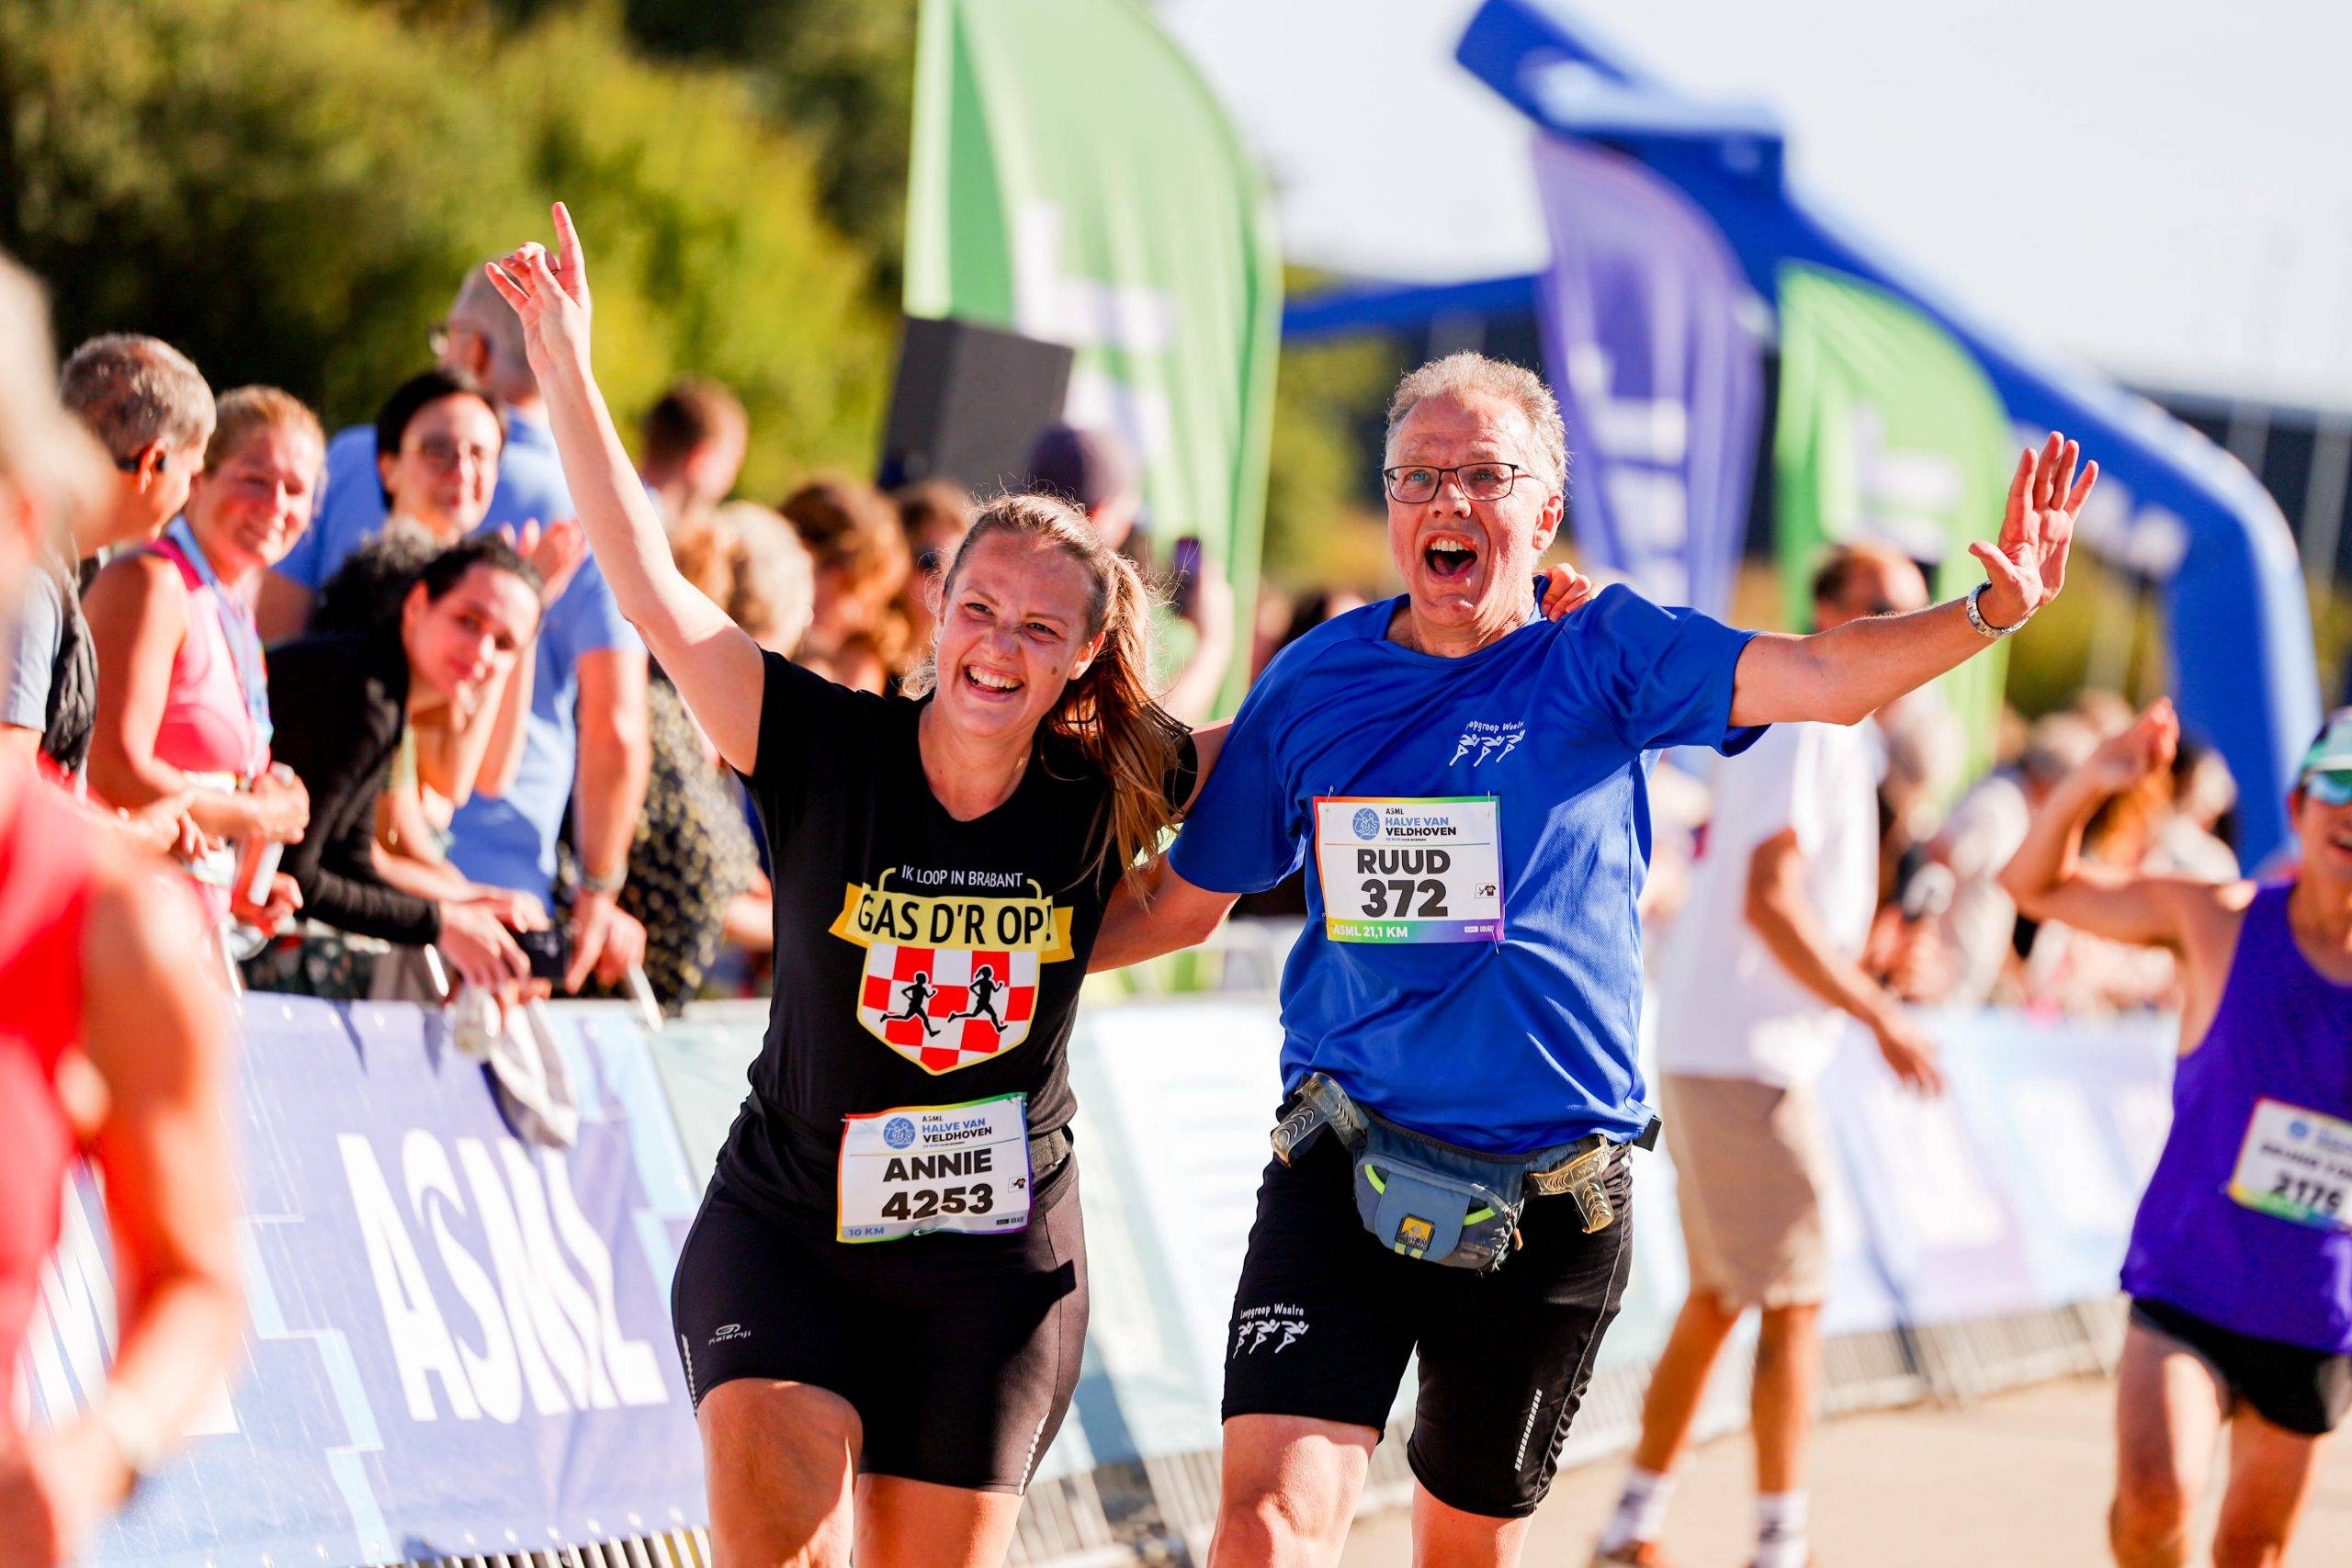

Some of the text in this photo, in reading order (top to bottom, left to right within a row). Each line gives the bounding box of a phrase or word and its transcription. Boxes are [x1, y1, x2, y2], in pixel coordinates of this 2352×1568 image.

[1385, 817, 1449, 826] HALVE VAN
[1385, 827, 1457, 837] VELDHOVEN
[1357, 849, 1451, 874] RUUD
[901, 864, 1023, 887] IK LOOP IN BRABANT
[1361, 878, 1448, 918] 372
[858, 893, 1052, 945] GAS D'R OP!
[1333, 924, 1408, 939] ASML 21,1 KM
[922, 1118, 986, 1134] HALVE VAN
[922, 1126, 992, 1143] VELDHOVEN
[883, 1148, 992, 1182] ANNIE
[881, 1182, 993, 1221] 4253
[849, 1226, 885, 1236] 10 KM
[336, 1128, 670, 1425] ASML
[1273, 1303, 1305, 1316] Waalre
